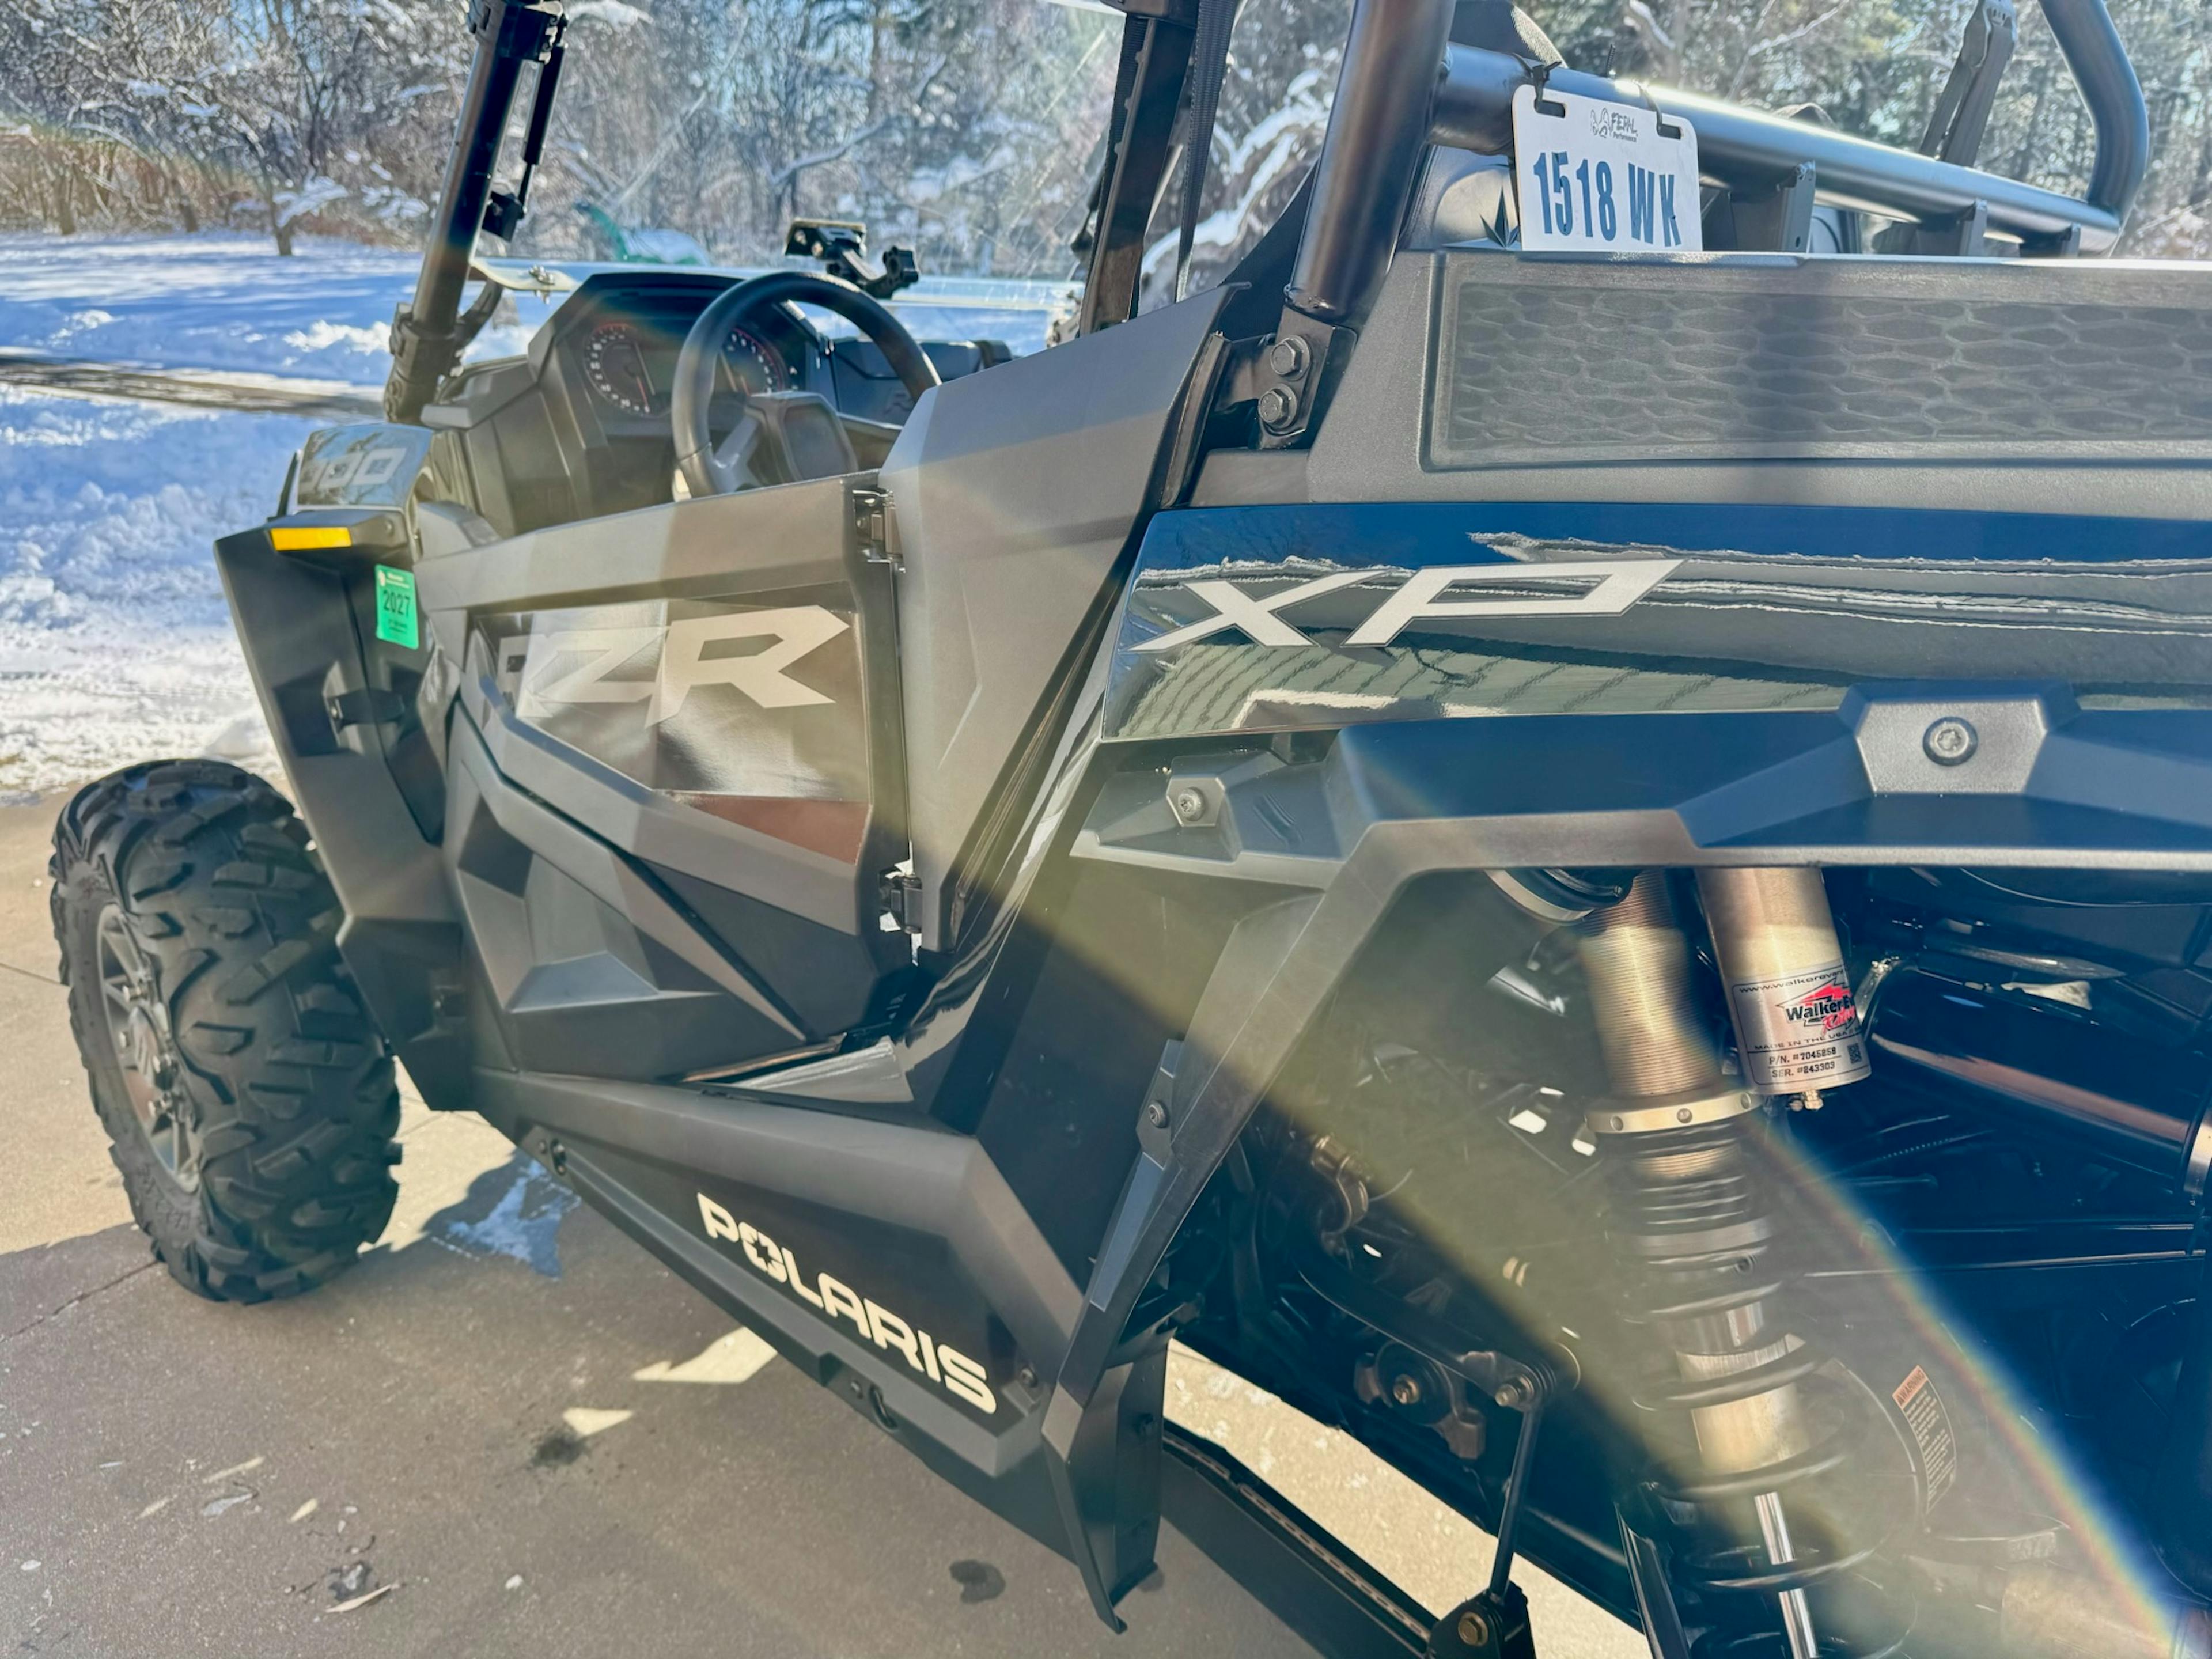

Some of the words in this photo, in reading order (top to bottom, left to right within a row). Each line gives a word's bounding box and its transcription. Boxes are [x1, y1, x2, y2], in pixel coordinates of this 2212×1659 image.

[1533, 151, 1616, 241] 1518
[1628, 162, 1681, 247] WK
[382, 589, 410, 618] 2027
[1120, 558, 1687, 653] XP
[1786, 1000, 1842, 1021] Walker
[1804, 1037, 1827, 1045] THE
[697, 1192, 997, 1414] POLARIS
